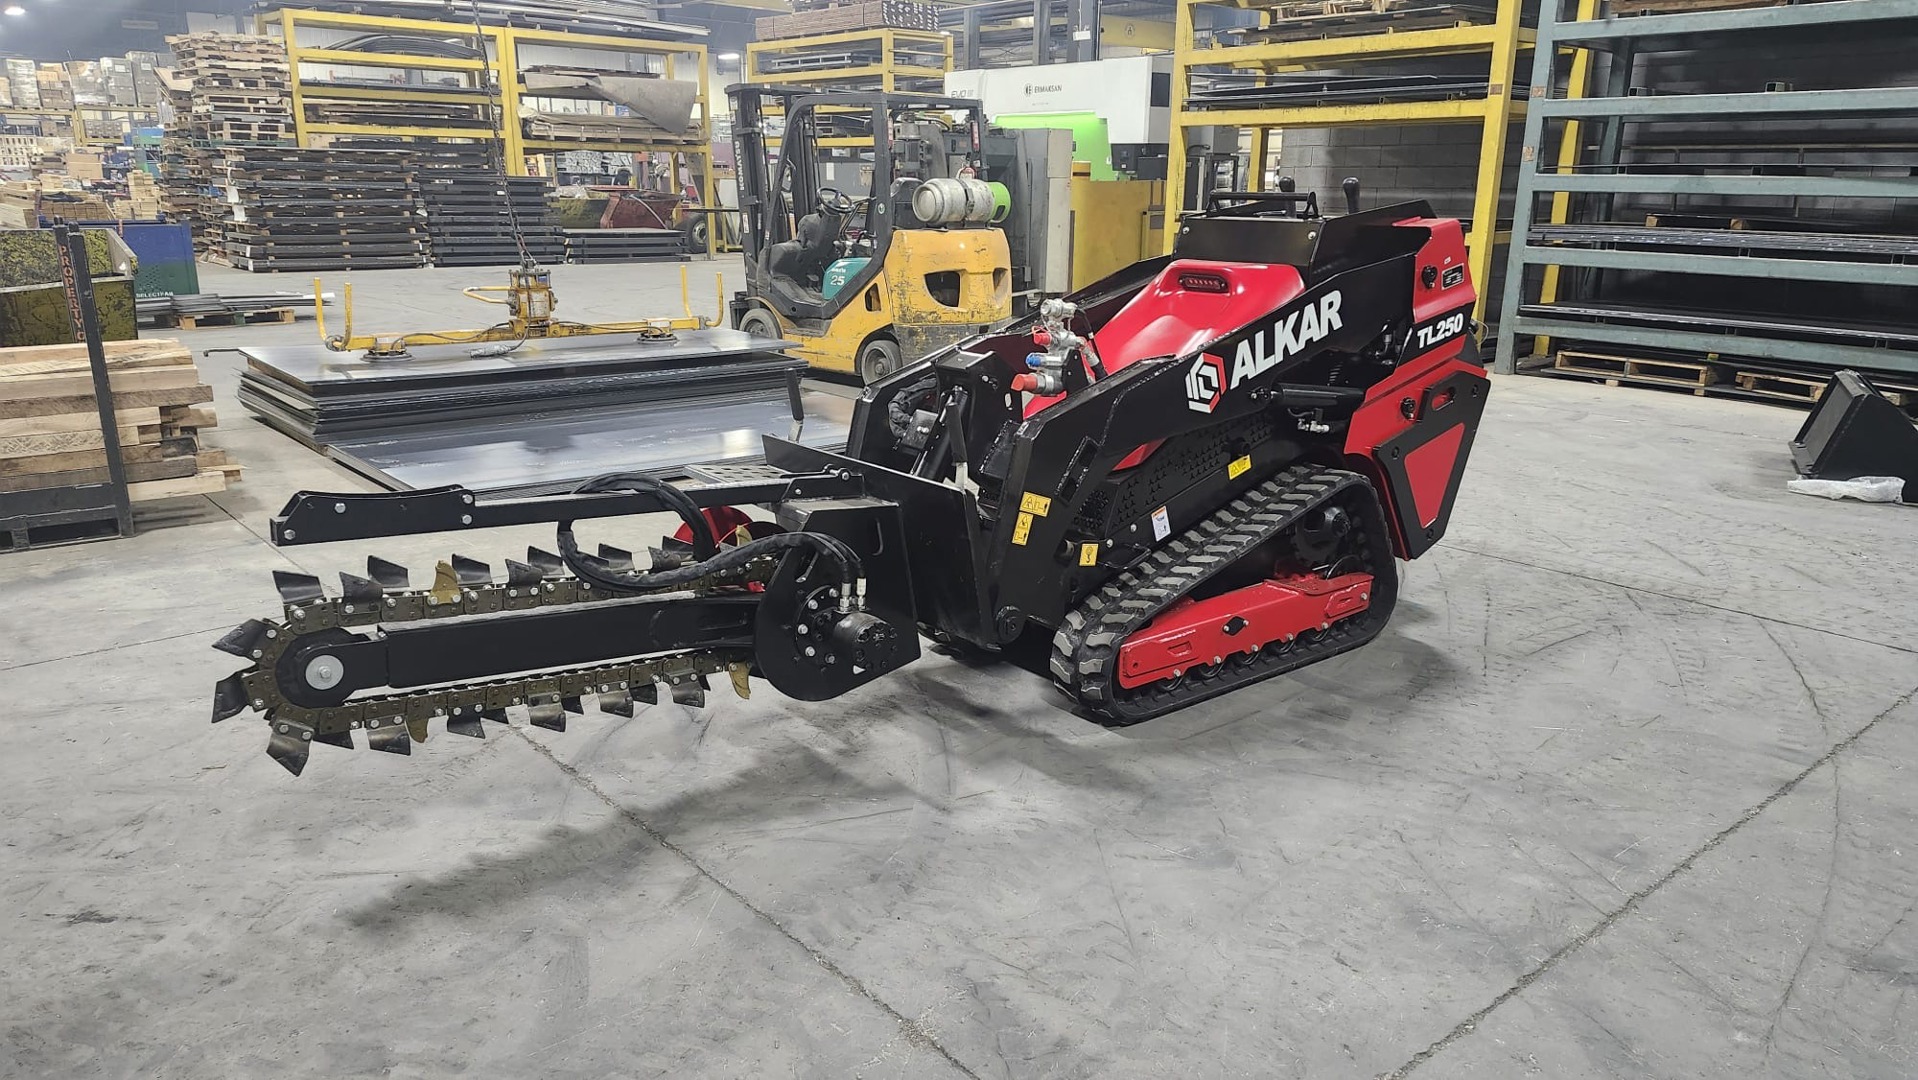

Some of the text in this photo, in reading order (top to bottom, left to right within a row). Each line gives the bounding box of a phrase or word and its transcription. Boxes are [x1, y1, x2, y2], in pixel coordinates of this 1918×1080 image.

[734, 141, 744, 191] KOMATSU
[59, 245, 82, 328] PROPERTY
[830, 275, 845, 286] 25
[1230, 290, 1343, 390] ALKAR
[1417, 313, 1464, 349] TL250
